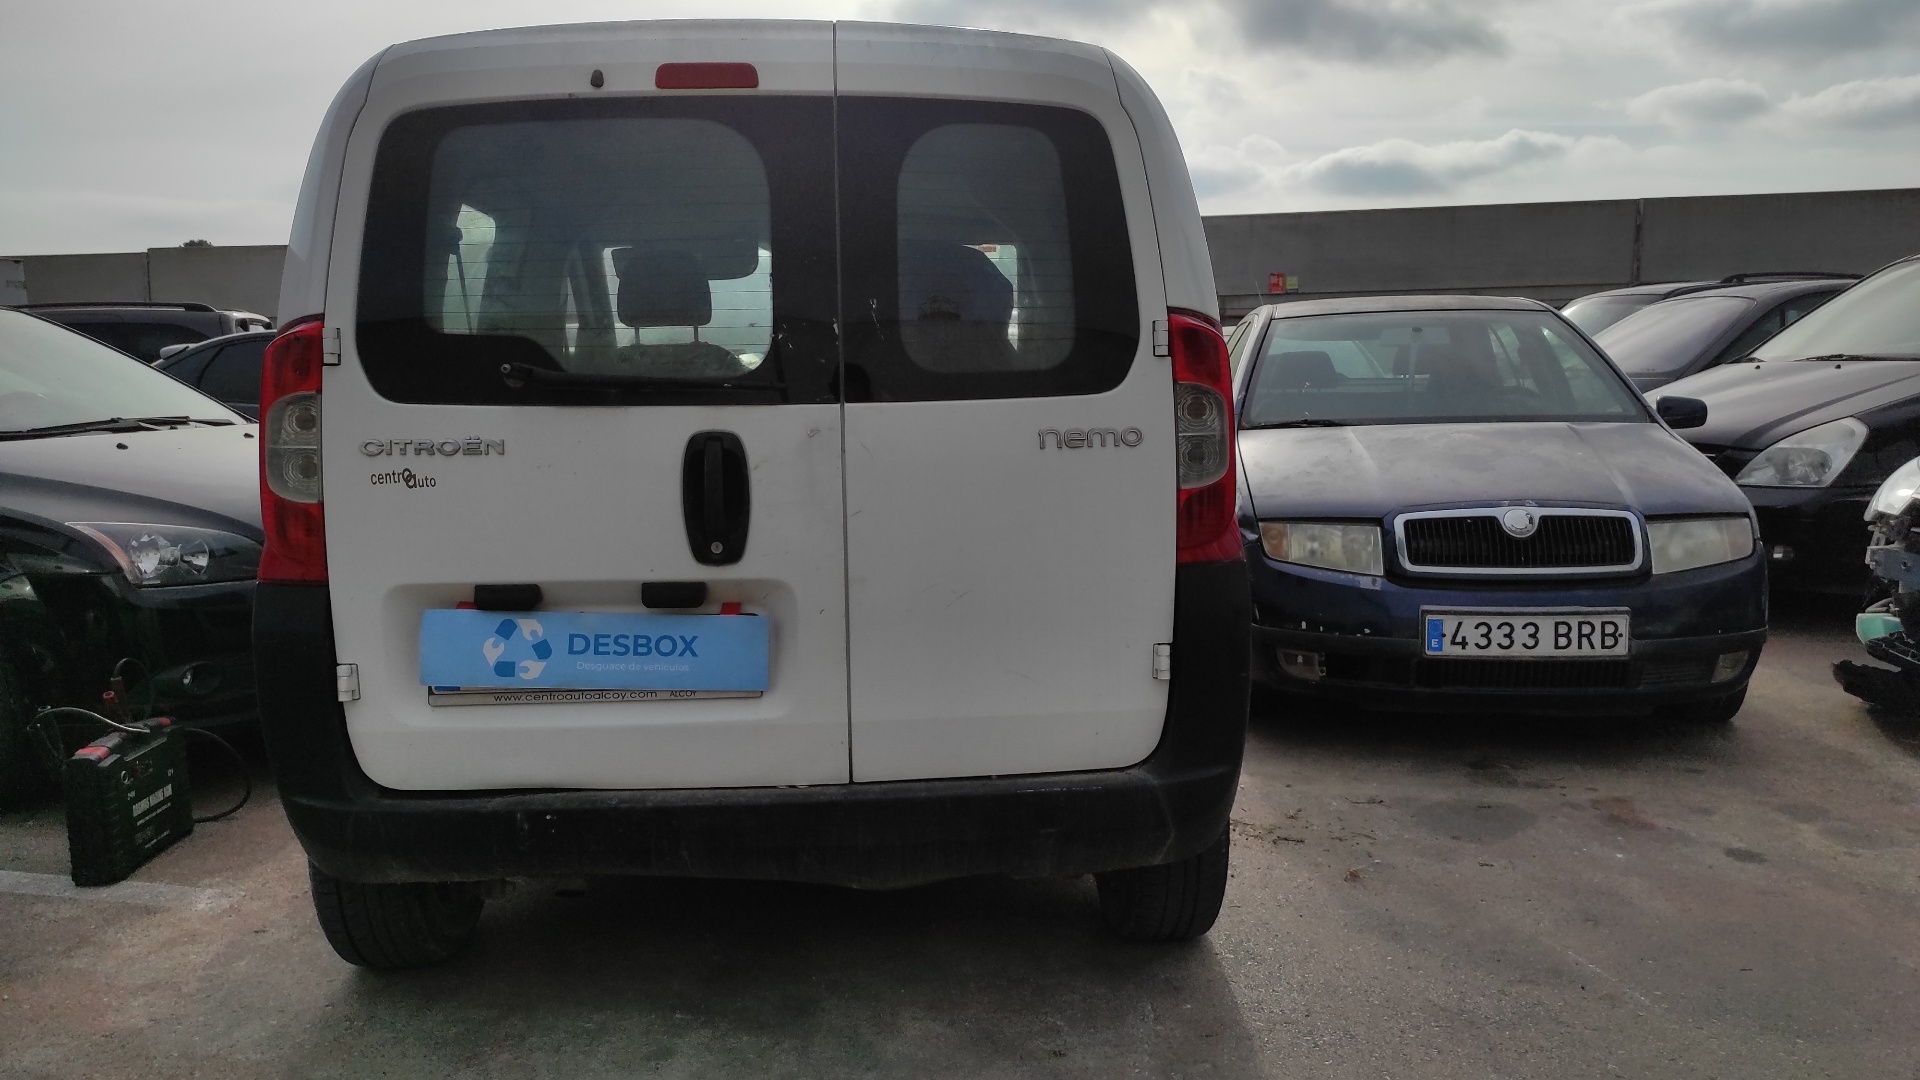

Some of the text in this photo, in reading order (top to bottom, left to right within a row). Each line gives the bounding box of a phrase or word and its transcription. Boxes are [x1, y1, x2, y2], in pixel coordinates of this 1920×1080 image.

[359, 435, 505, 456] CITROËN
[1038, 427, 1143, 449] nemo
[1450, 620, 1619, 650] 4333 BRB
[567, 633, 699, 657] DESBOX
[1431, 639, 1439, 648] E
[576, 661, 626, 671] Desguace
[628, 662, 641, 671] de
[494, 690, 657, 702] www.centroautoalcoy.com
[669, 690, 697, 698] ALCOY
